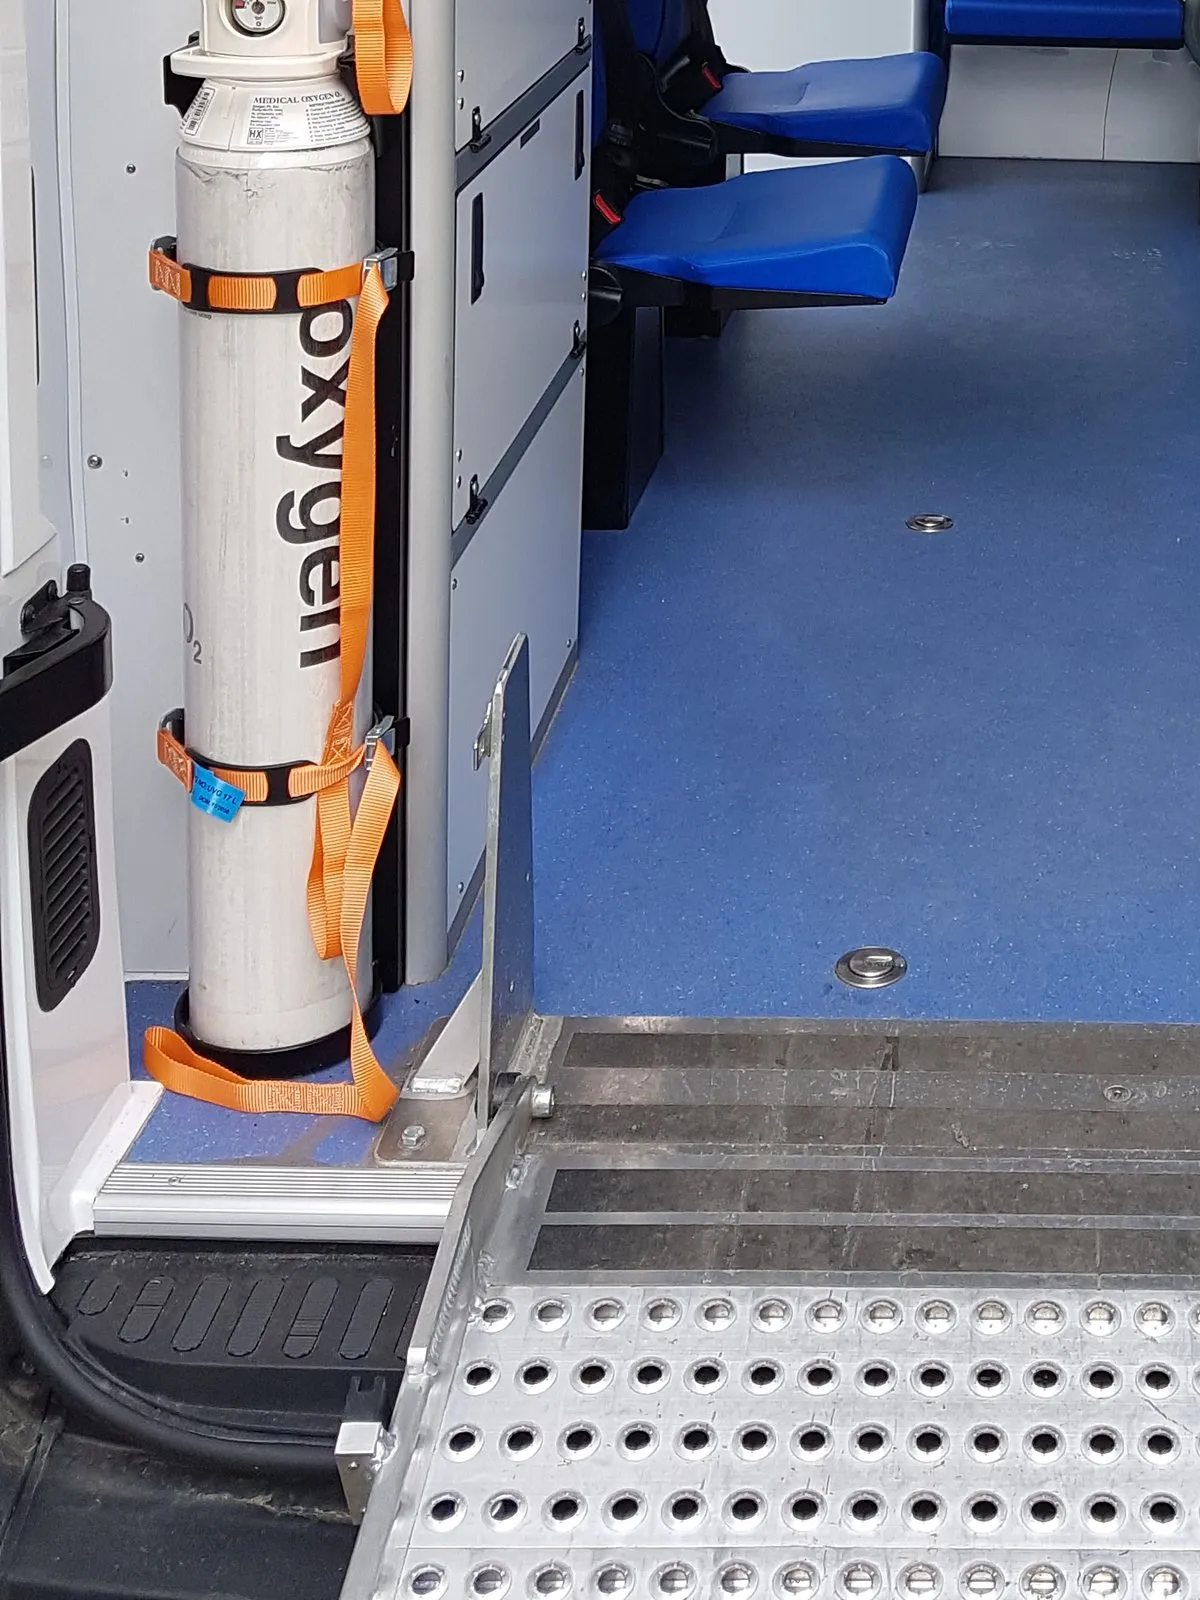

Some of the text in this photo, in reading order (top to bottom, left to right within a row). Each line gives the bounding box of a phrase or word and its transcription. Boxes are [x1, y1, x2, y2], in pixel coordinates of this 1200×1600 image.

[253, 97, 300, 105] MEDICAL
[300, 93, 334, 103] OXYGEN
[250, 129, 262, 139] HX
[276, 298, 352, 668] oxygen
